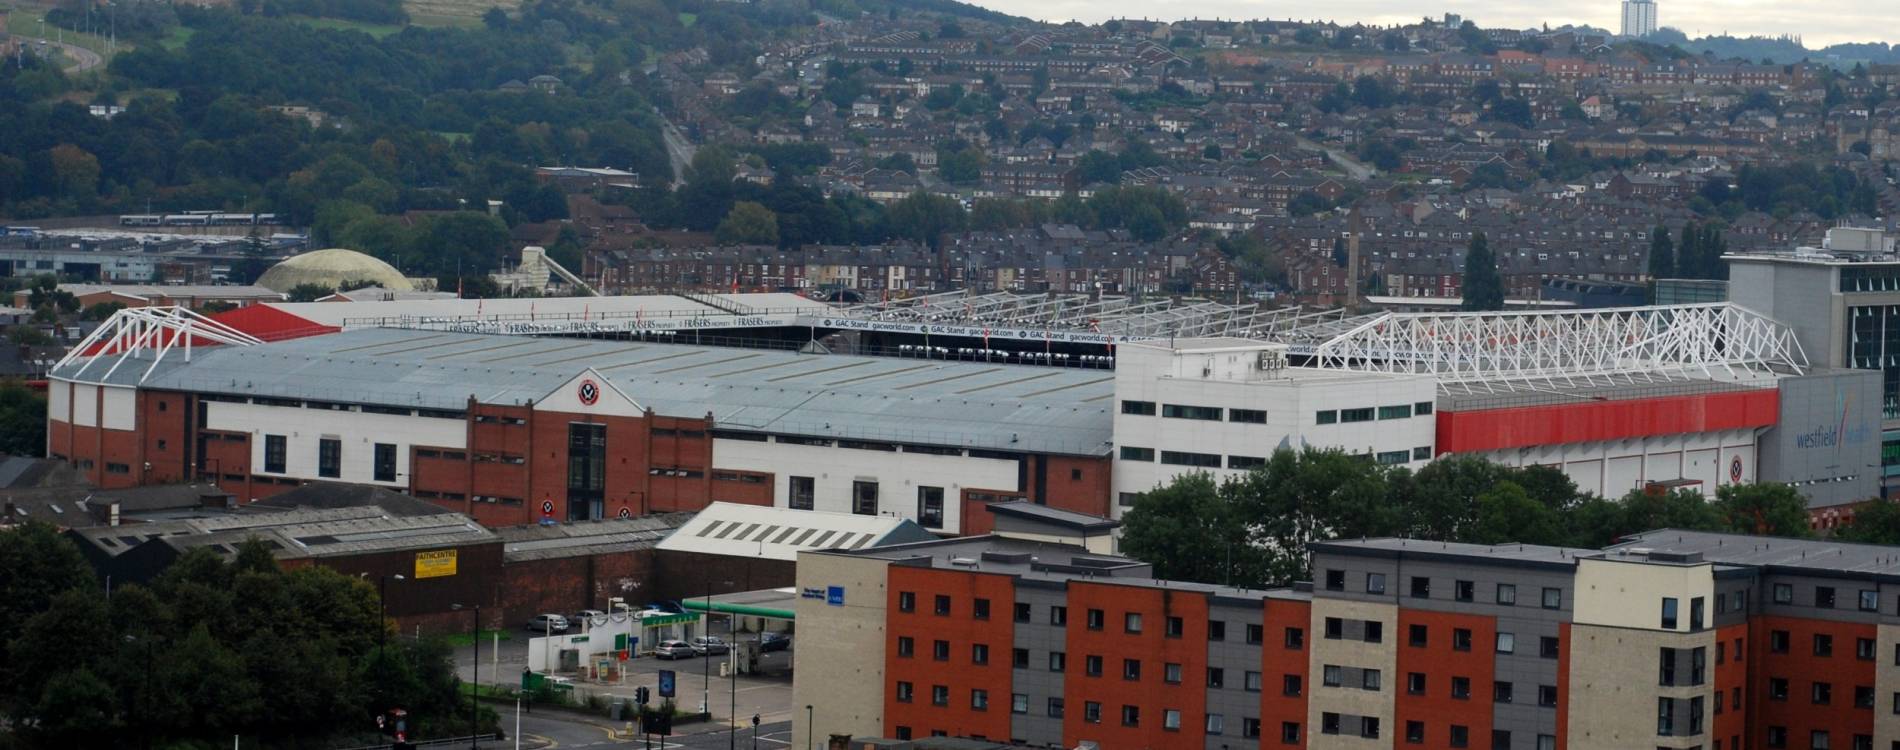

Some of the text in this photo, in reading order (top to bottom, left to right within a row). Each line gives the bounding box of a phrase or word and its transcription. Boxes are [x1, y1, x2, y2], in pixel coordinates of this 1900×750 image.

[738, 317, 764, 326] FRASERS
[835, 319, 848, 327] GAC
[872, 322, 915, 331] gacworld.com
[931, 325, 944, 333] GAC
[947, 326, 965, 334] Stand
[1796, 424, 1837, 448] westfield
